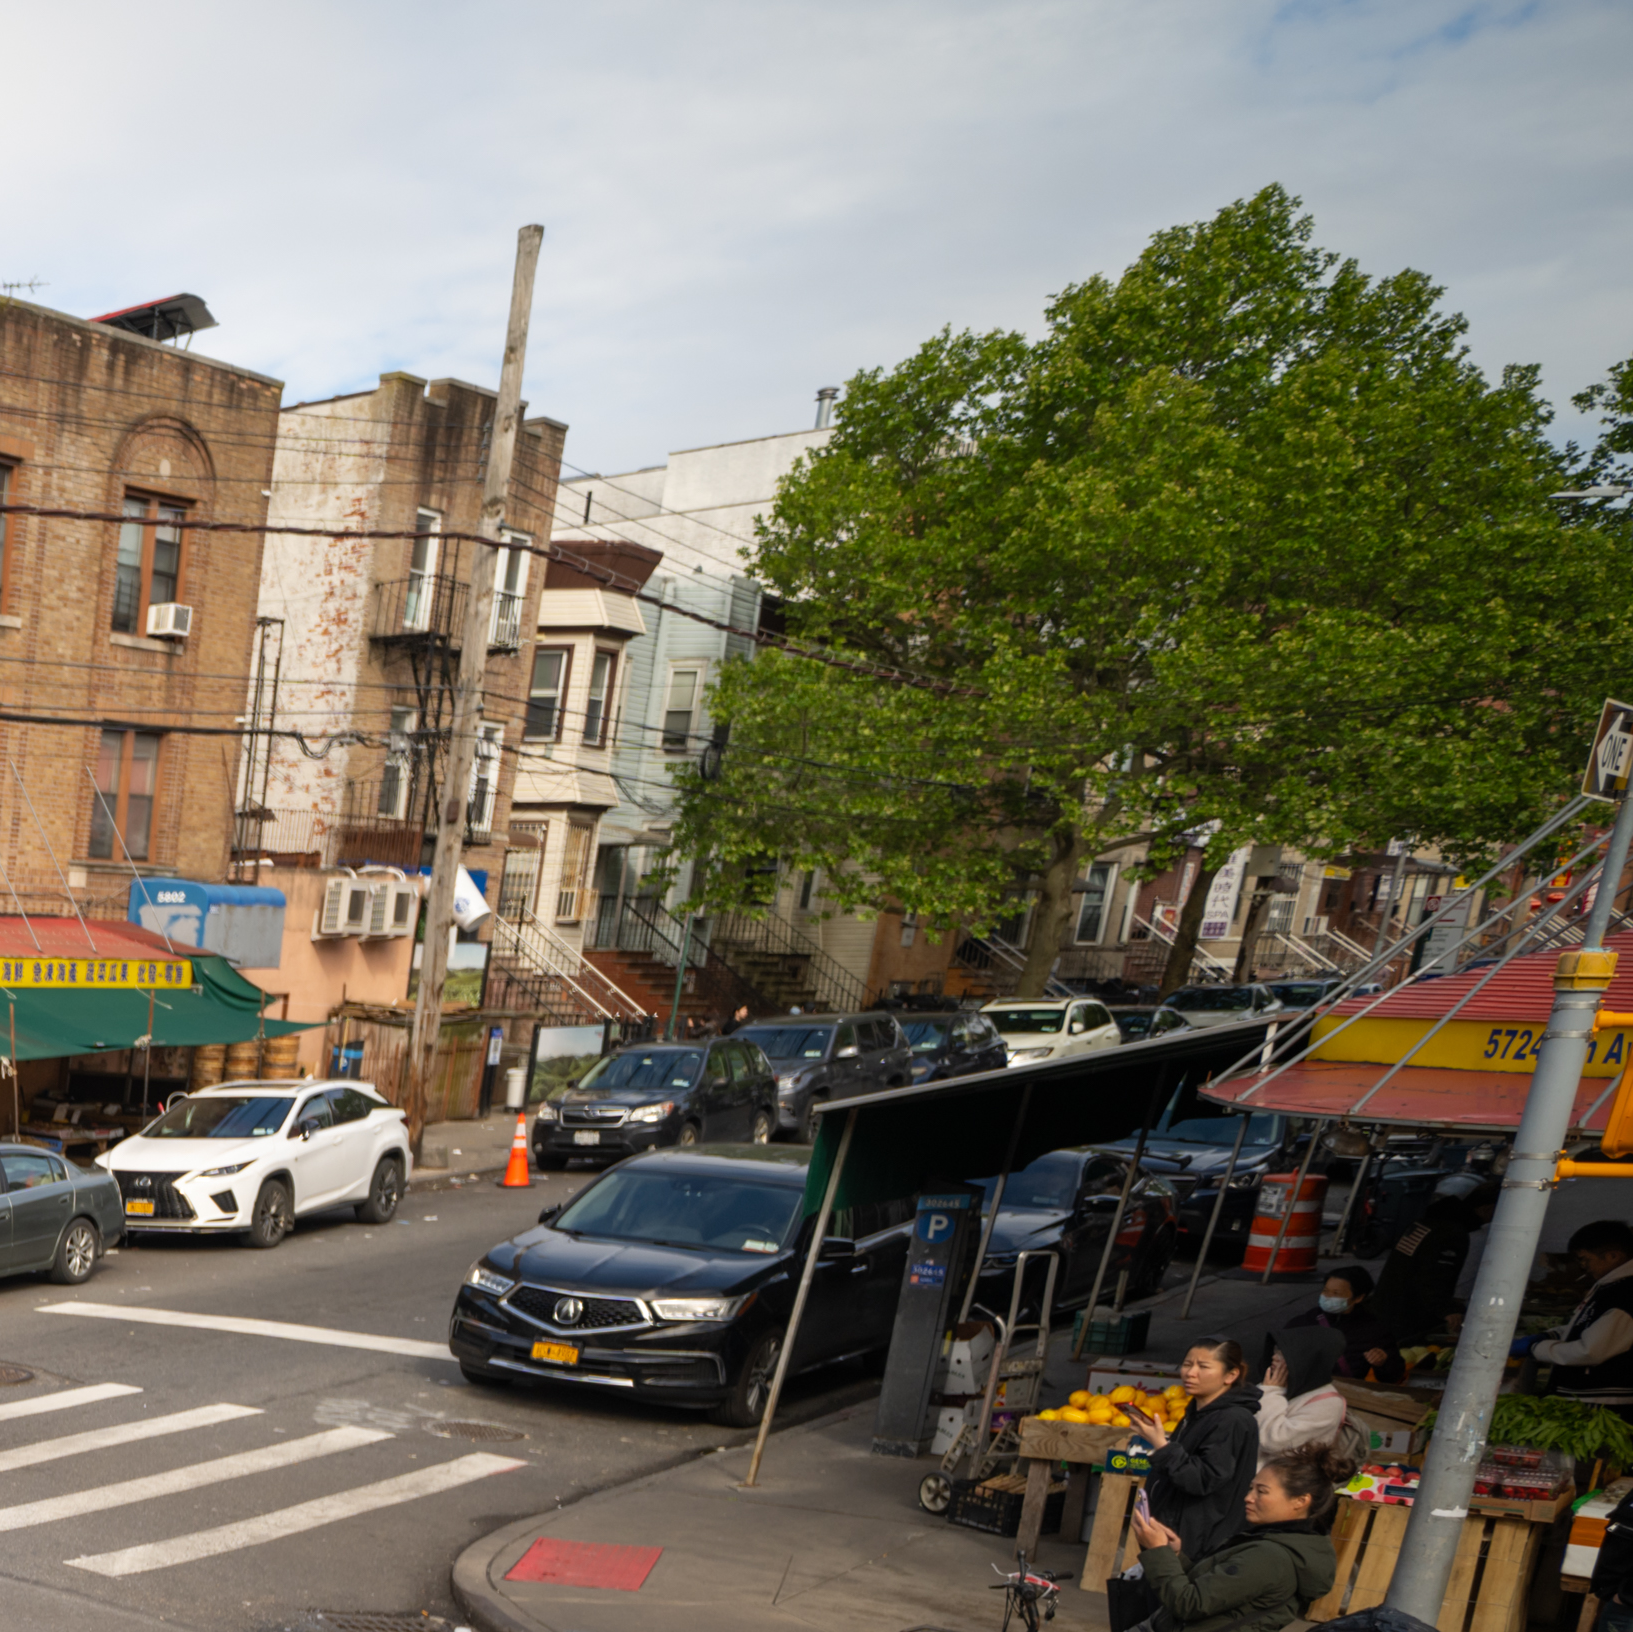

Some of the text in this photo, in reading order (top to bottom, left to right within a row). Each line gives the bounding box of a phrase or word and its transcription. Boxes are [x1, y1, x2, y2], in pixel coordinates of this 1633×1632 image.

[1602, 733, 1628, 772] ONE
[1206, 910, 1229, 920] SPA
[927, 1214, 949, 1240] P
